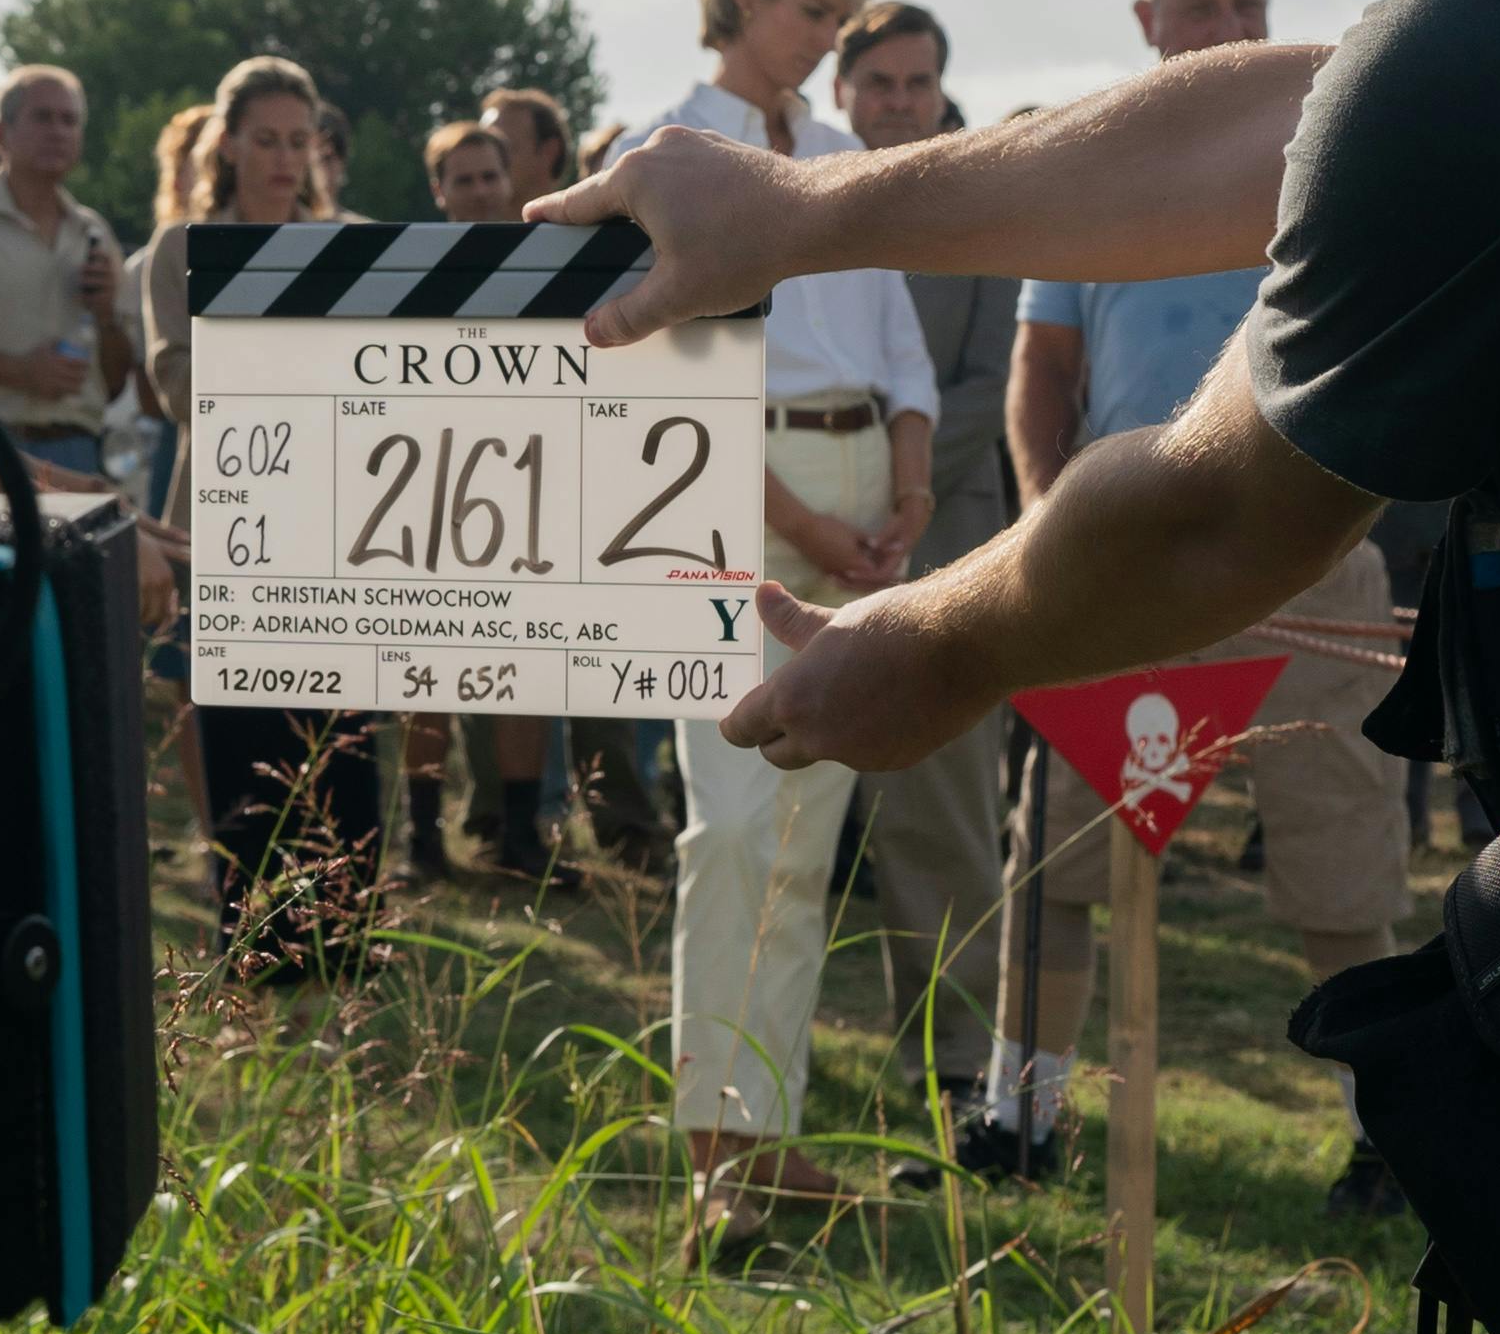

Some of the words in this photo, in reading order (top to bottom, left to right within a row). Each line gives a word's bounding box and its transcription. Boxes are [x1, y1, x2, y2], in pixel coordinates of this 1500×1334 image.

[457, 327, 487, 339] THE
[354, 343, 591, 386] CROWN
[199, 400, 215, 414] EP
[341, 400, 387, 416] SLATE
[588, 402, 628, 418] TAKE
[216, 421, 291, 477] 602
[198, 489, 249, 505] SCENE
[597, 416, 726, 572] 2
[227, 514, 271, 567] 61
[666, 569, 755, 582] PANAVISION
[199, 584, 235, 603] DIR:
[252, 585, 356, 606] CHRISTIAN
[364, 588, 512, 608] SCHWOCHOW
[708, 598, 749, 642] Y
[199, 614, 246, 633] DOP:
[252, 615, 348, 635] ADRIANO
[355, 617, 464, 638] GOLDMAN
[471, 620, 518, 642] ASC,
[526, 622, 569, 643] BSC,
[576, 623, 618, 641] ABC
[198, 646, 227, 658] DATE
[382, 651, 412, 663] LENS
[573, 655, 602, 668] ROLL
[217, 667, 342, 695] 12/09/22
